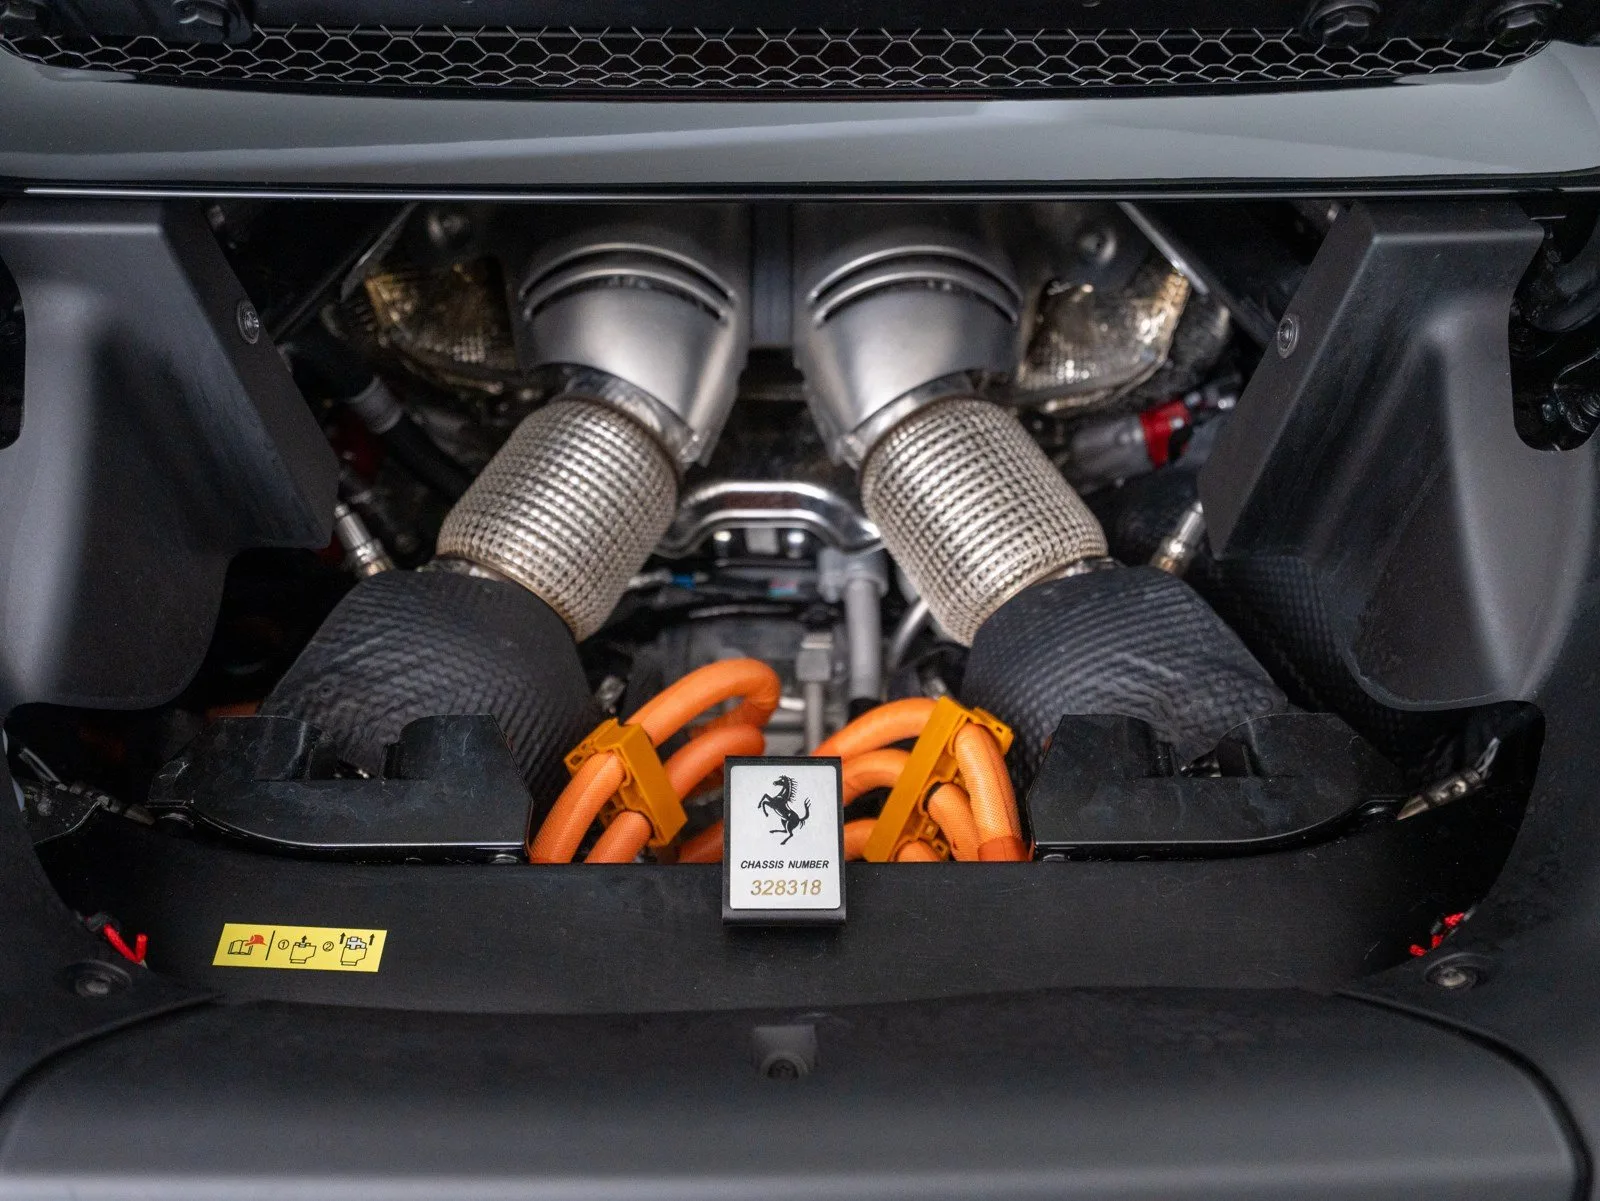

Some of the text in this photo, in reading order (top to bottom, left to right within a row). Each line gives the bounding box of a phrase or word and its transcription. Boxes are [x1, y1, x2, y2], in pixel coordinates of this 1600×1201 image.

[740, 860, 829, 869] CHASSIS NUMBER
[750, 879, 822, 896] 328318
